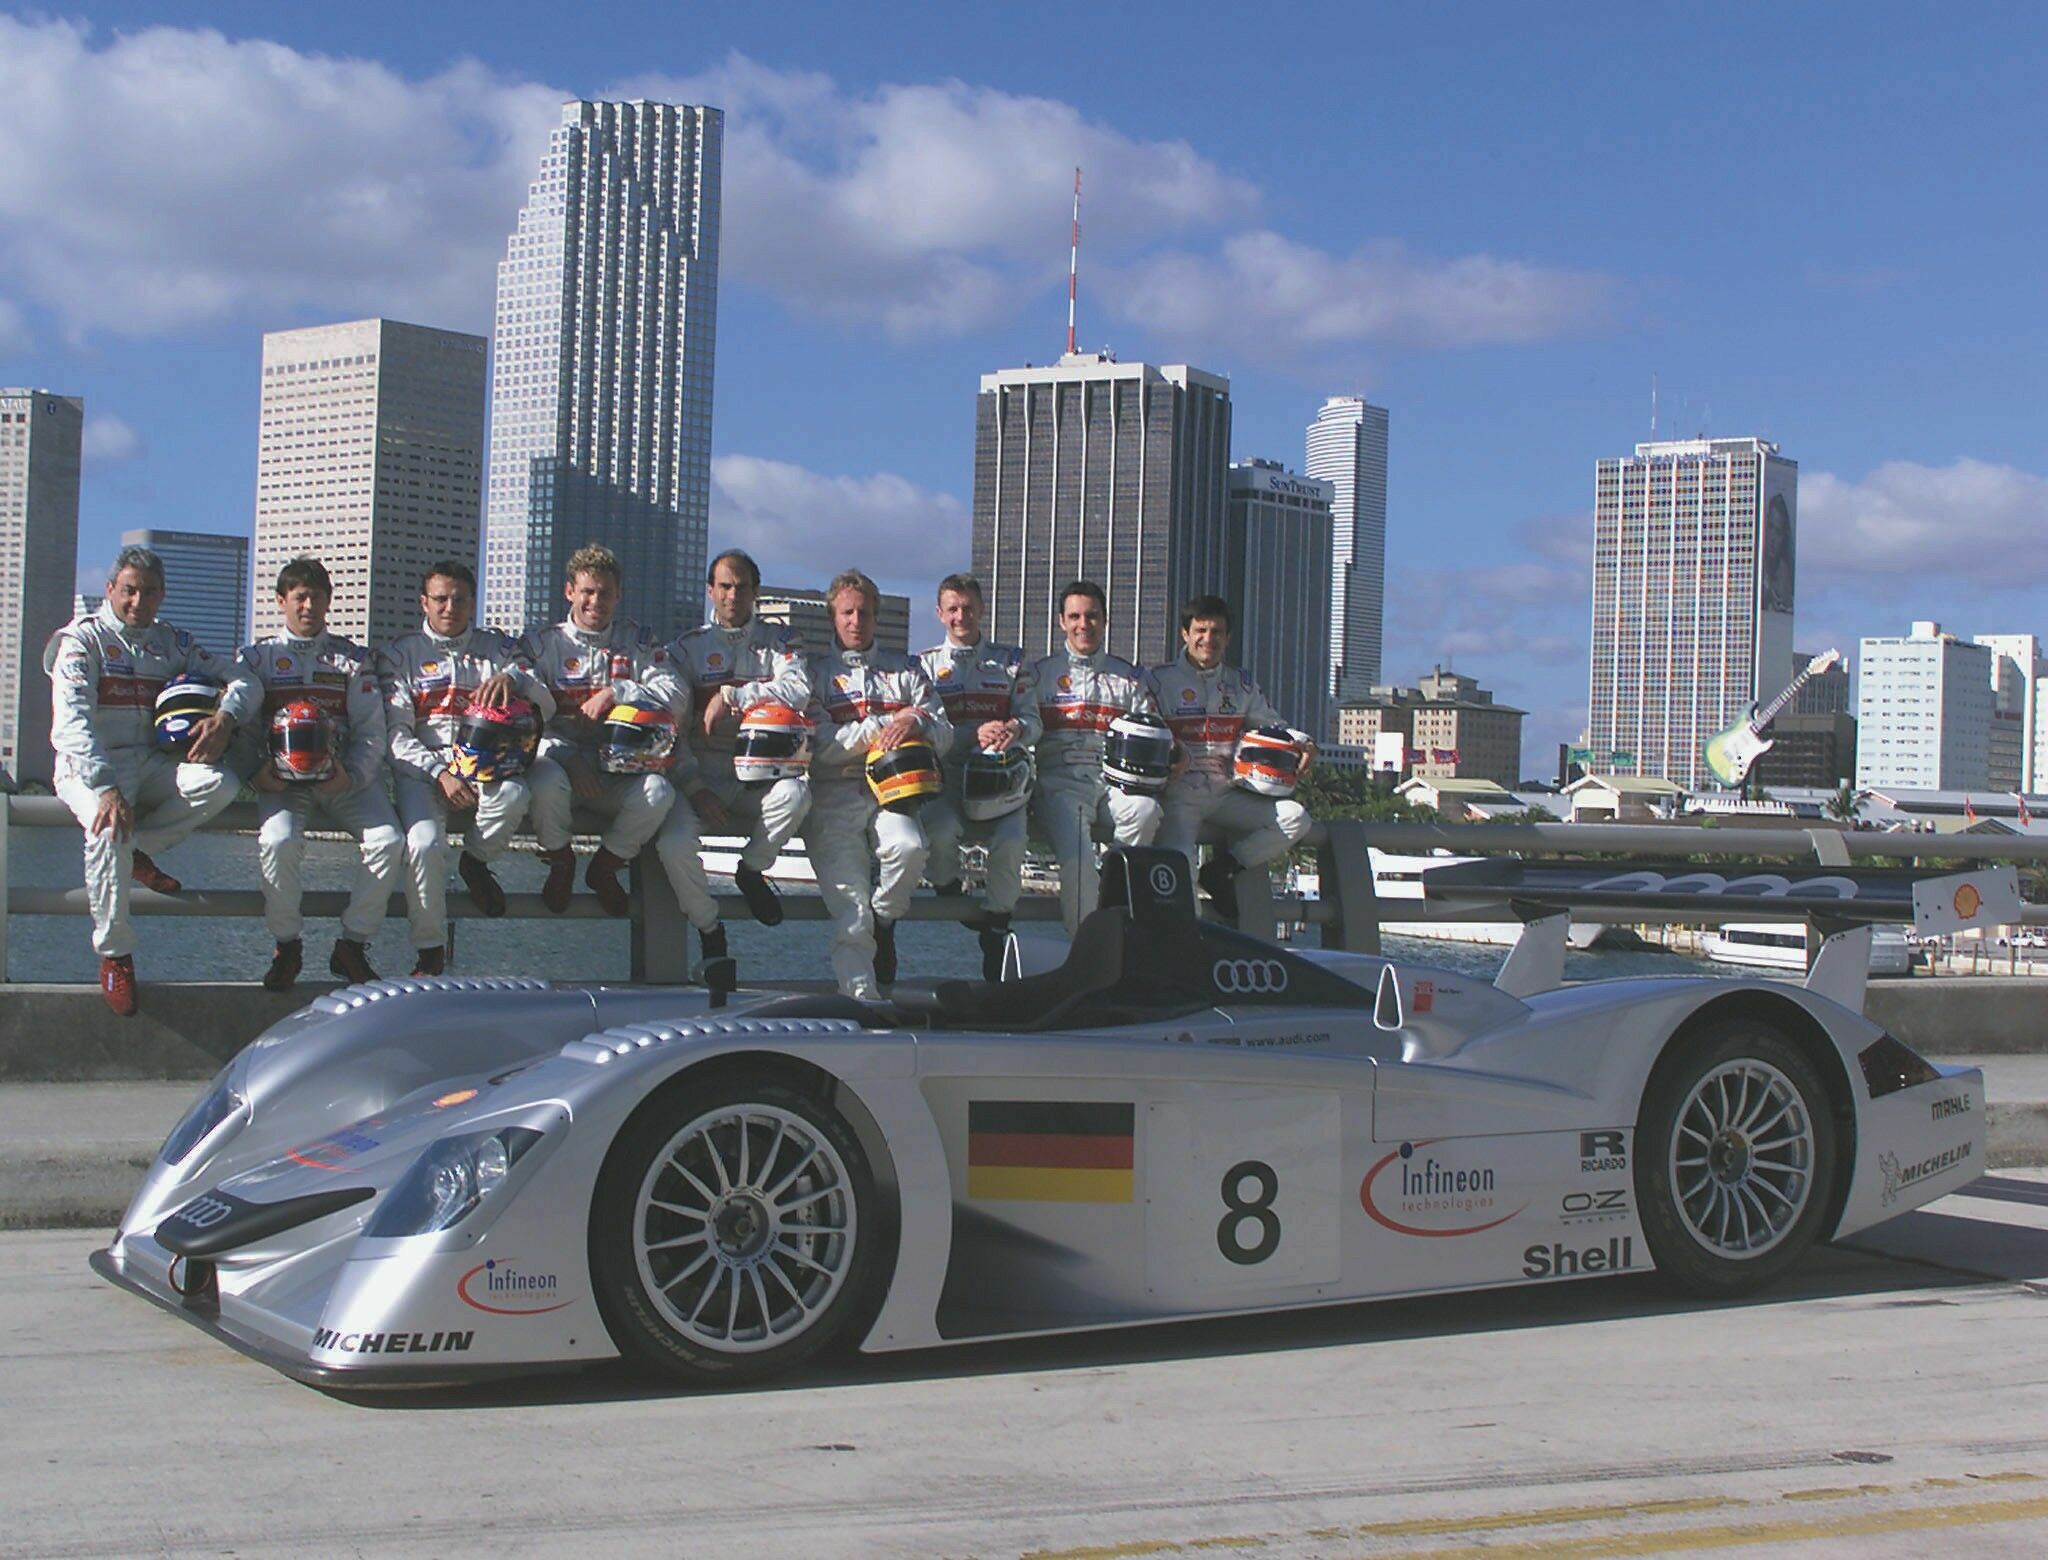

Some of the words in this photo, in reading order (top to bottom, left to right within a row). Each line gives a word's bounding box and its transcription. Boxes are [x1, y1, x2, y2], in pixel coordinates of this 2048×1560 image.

[1931, 1093, 1972, 1121] MAHLE
[1400, 1149, 1494, 1196] Infineon
[1580, 1156, 1627, 1173] RICARDO
[1901, 1141, 1972, 1184] MICHELIN
[1216, 1159, 1281, 1266] 8
[1402, 1195, 1494, 1212] technologies
[1522, 1236, 1632, 1279] Shell
[486, 1262, 557, 1291] Infineon
[312, 1326, 475, 1353] MICHELIN
